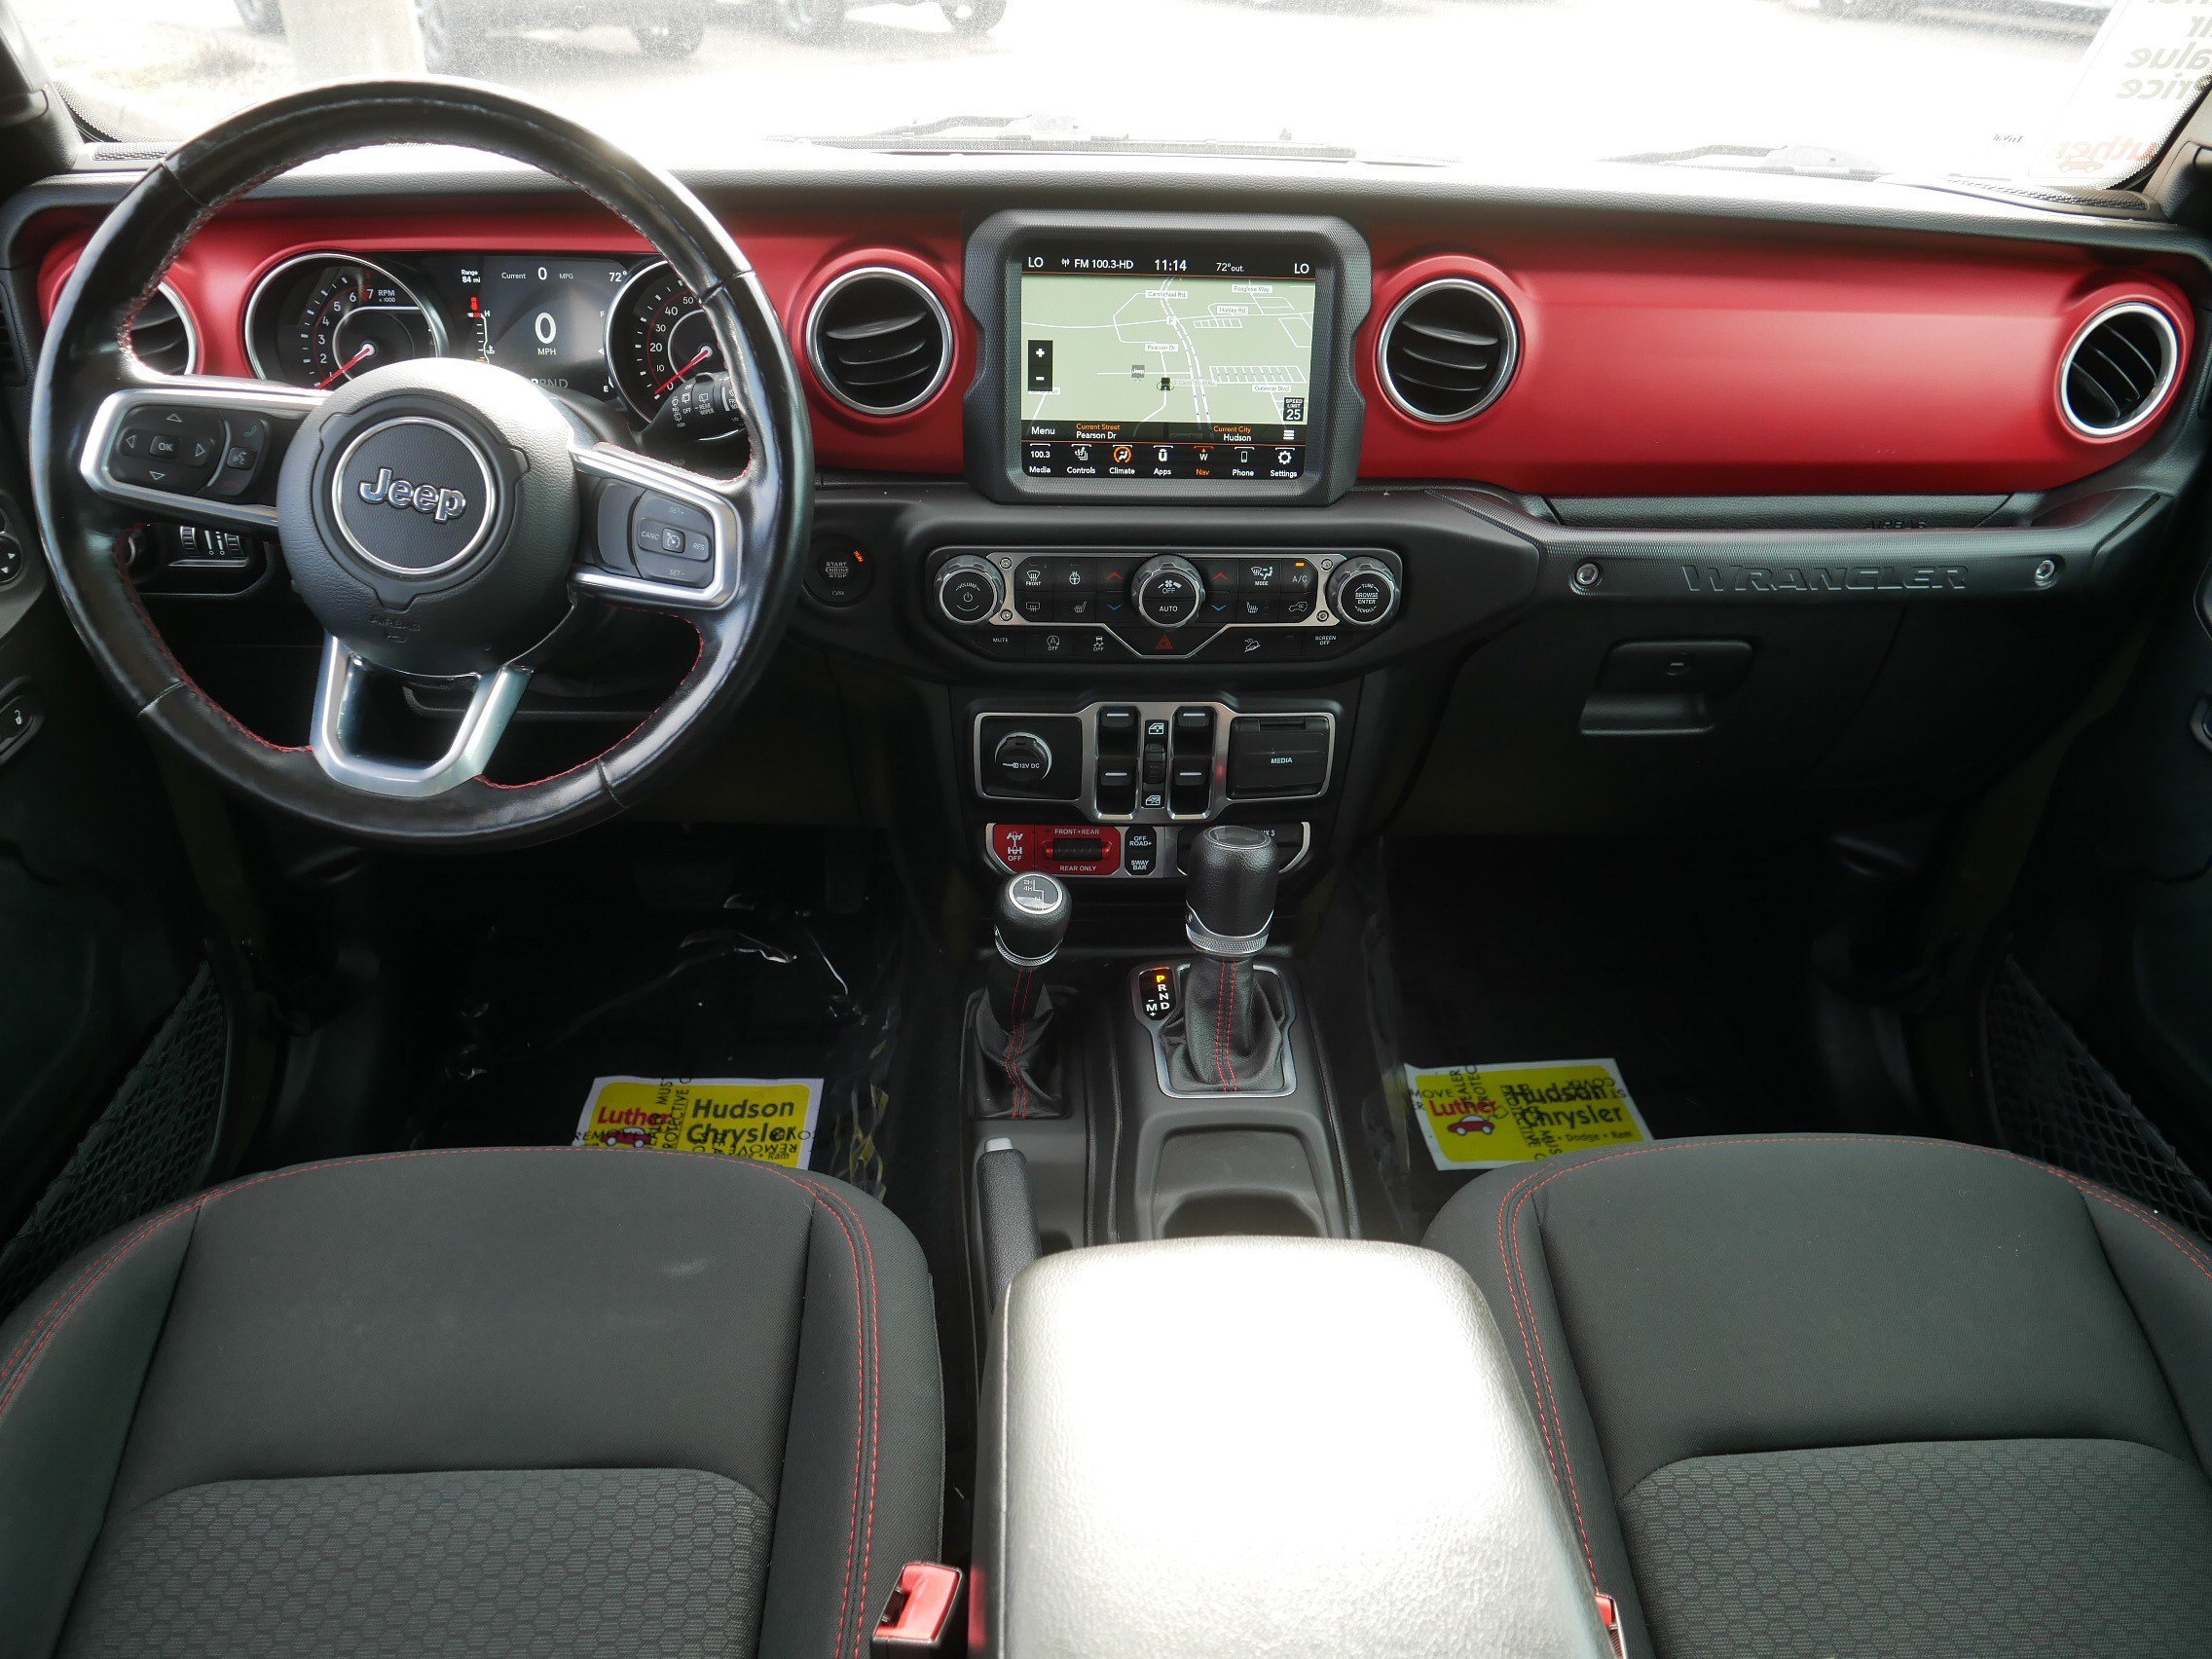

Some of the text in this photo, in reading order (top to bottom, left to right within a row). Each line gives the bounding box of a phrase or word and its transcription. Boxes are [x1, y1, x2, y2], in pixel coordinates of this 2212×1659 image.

[1028, 257, 1044, 268] LO
[1074, 259, 1134, 269] FM 100.3-HD
[1155, 259, 1187, 272] 11:14
[537, 267, 547, 280] 0
[1294, 263, 1309, 274] LO
[349, 291, 357, 303] 6
[682, 296, 694, 305] 50
[333, 301, 342, 312] 5
[664, 307, 679, 316] 40
[321, 315, 330, 326] 4
[535, 312, 557, 345] 0
[655, 323, 667, 332] 30
[317, 333, 326, 345] 3
[649, 342, 663, 352] 20
[318, 352, 328, 364] 2
[655, 363, 665, 372] 10
[1286, 409, 1301, 421] 25
[158, 442, 173, 452] OK
[1153, 467, 1172, 476] Apps
[359, 467, 467, 524] Jeep
[641, 531, 660, 540] CANC
[1681, 565, 1969, 592] WRANGLER
[1156, 975, 1165, 983] P
[1159, 992, 1169, 1001] N
[1146, 1003, 1158, 1012] M
[1510, 1082, 1608, 1105] Hudson
[692, 1098, 794, 1120] Hudson
[1429, 1099, 1496, 1118] Luther
[598, 1106, 673, 1126] Luther
[1520, 1104, 1624, 1129] Chrysler
[686, 1123, 797, 1148] Chrysler
